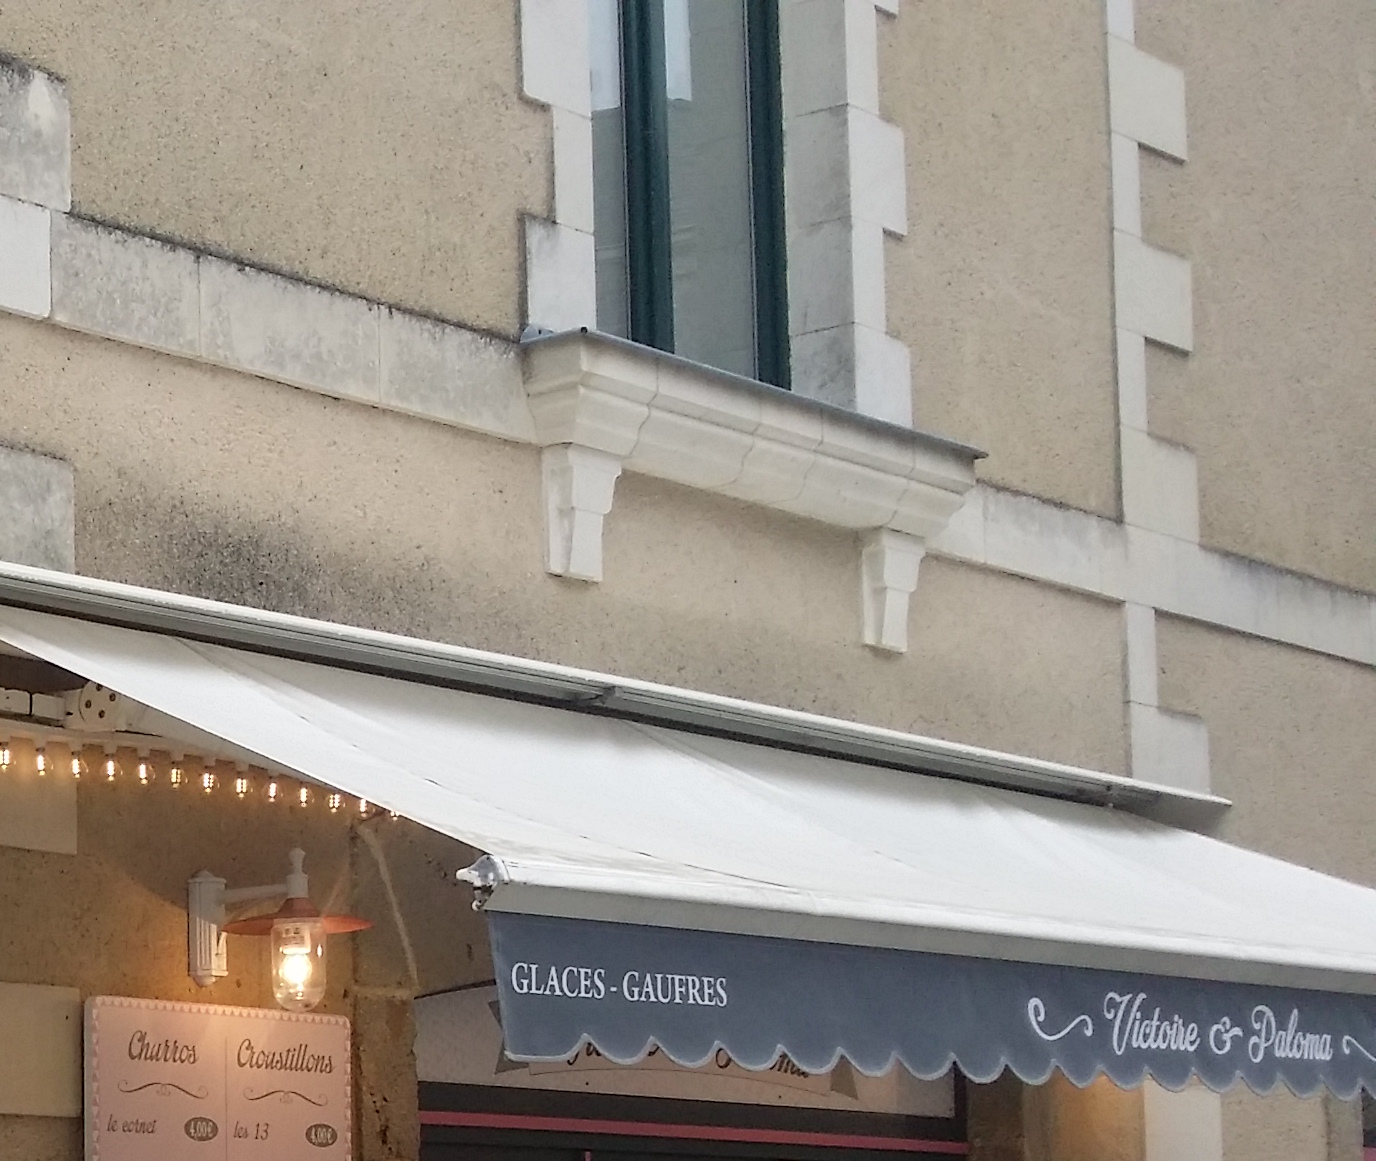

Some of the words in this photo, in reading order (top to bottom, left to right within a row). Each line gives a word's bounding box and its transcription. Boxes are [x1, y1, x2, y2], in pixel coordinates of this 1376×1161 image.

[510, 961, 606, 1000] GLACES
[622, 970, 728, 1007] GAUFRES
[1103, 991, 1200, 1056] Victoire
[1209, 1016, 1243, 1055] &
[1249, 1004, 1333, 1063] Paloma
[128, 1029, 198, 1065] Churros
[236, 1038, 335, 1074] Croustillons
[106, 1114, 118, 1133] le
[121, 1118, 157, 1135] cornet
[233, 1122, 249, 1140] les
[254, 1122, 270, 1141] 13
